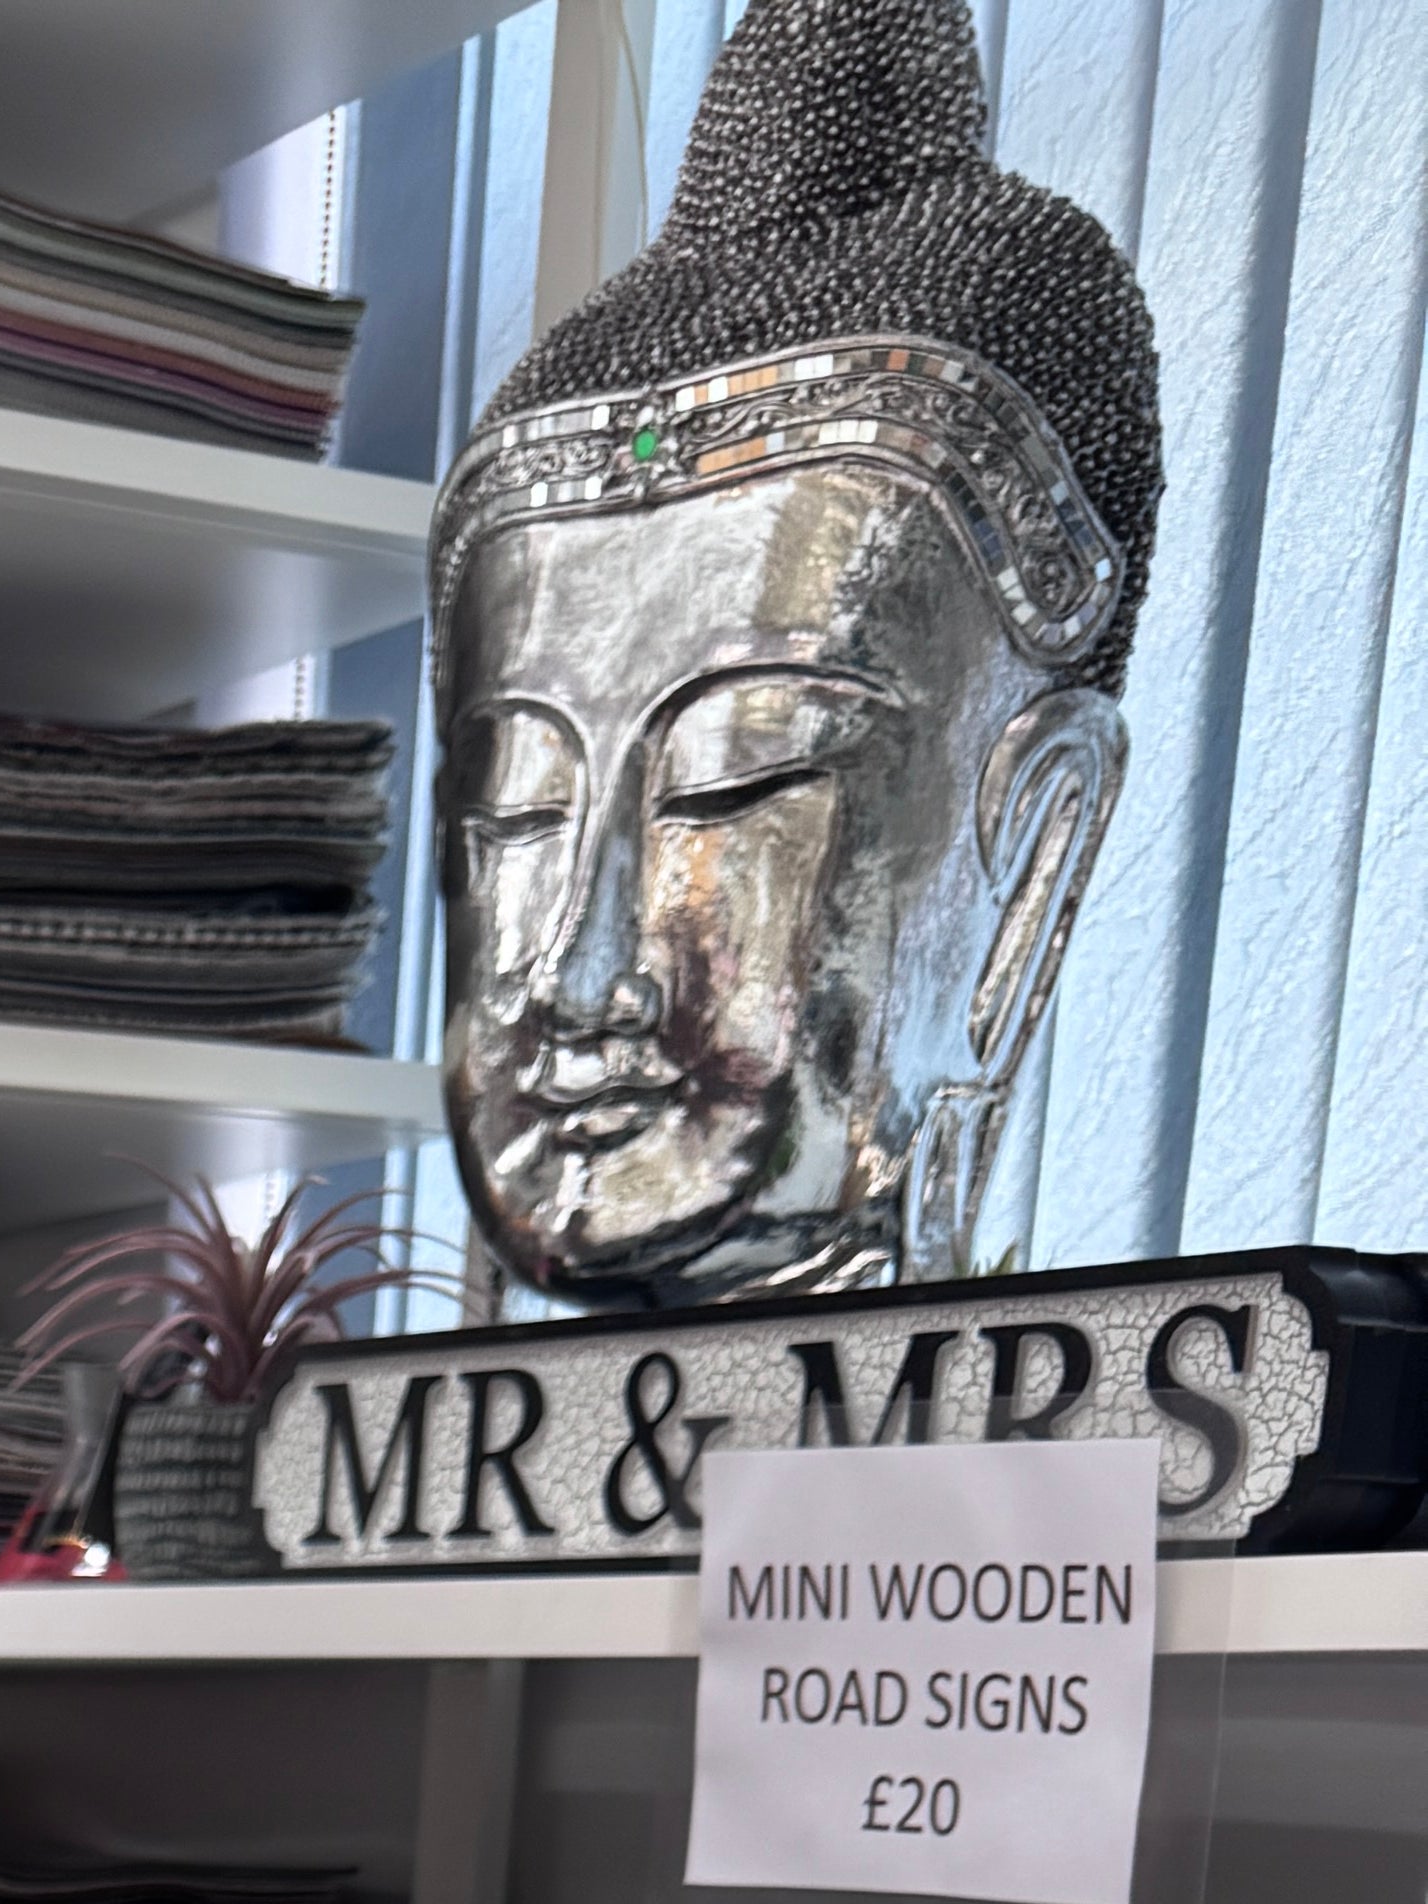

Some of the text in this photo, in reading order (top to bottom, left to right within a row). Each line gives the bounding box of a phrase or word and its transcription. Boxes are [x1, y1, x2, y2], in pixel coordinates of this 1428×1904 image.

[304, 1303, 1257, 1547] MR & MRS
[727, 1562, 1133, 1626] MINI WOODEN
[760, 1666, 1089, 1736] ROAD SIGNS
[861, 1774, 962, 1837] £20
